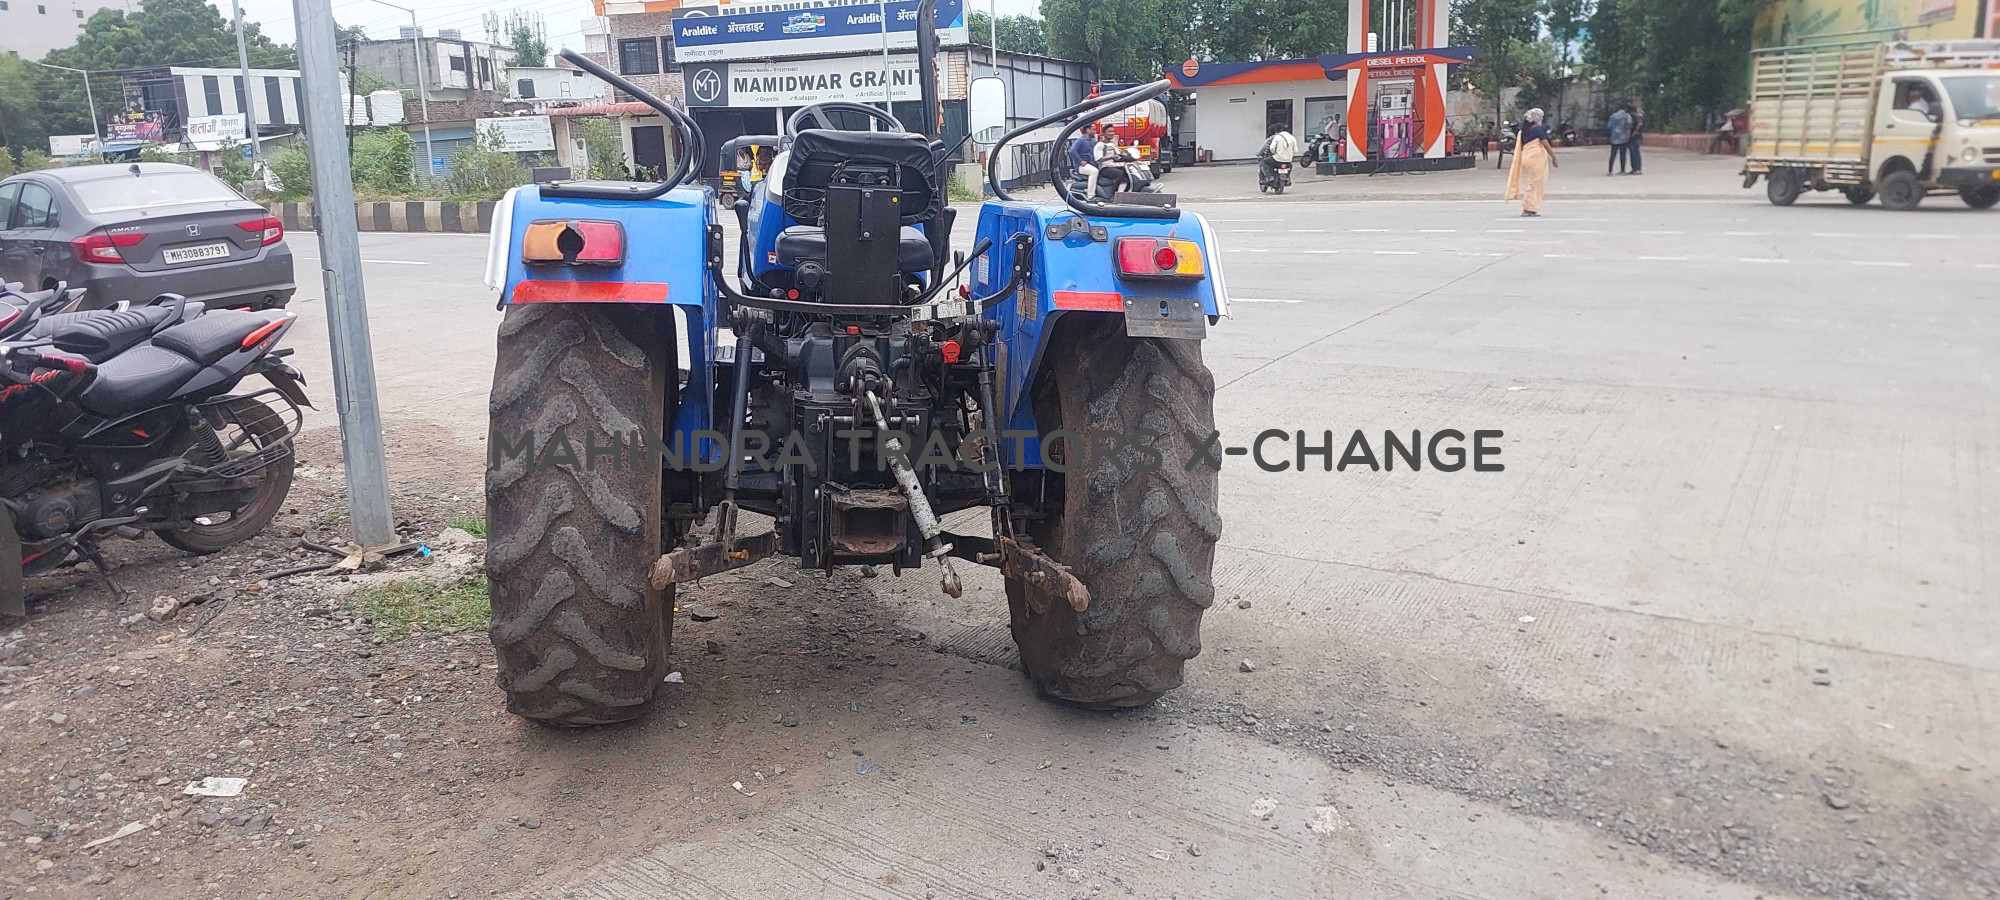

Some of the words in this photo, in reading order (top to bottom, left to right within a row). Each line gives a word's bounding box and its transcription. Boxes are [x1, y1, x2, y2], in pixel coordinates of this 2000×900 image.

[682, 25, 718, 37] Araldite
[1367, 58, 1394, 66] DIESEL
[1395, 56, 1427, 64] PETROL
[1368, 70, 1392, 78] PETROL
[734, 74, 842, 93] MAMIDWAR
[190, 119, 217, 135] बालाजी
[171, 245, 226, 260] MH30BB3791
